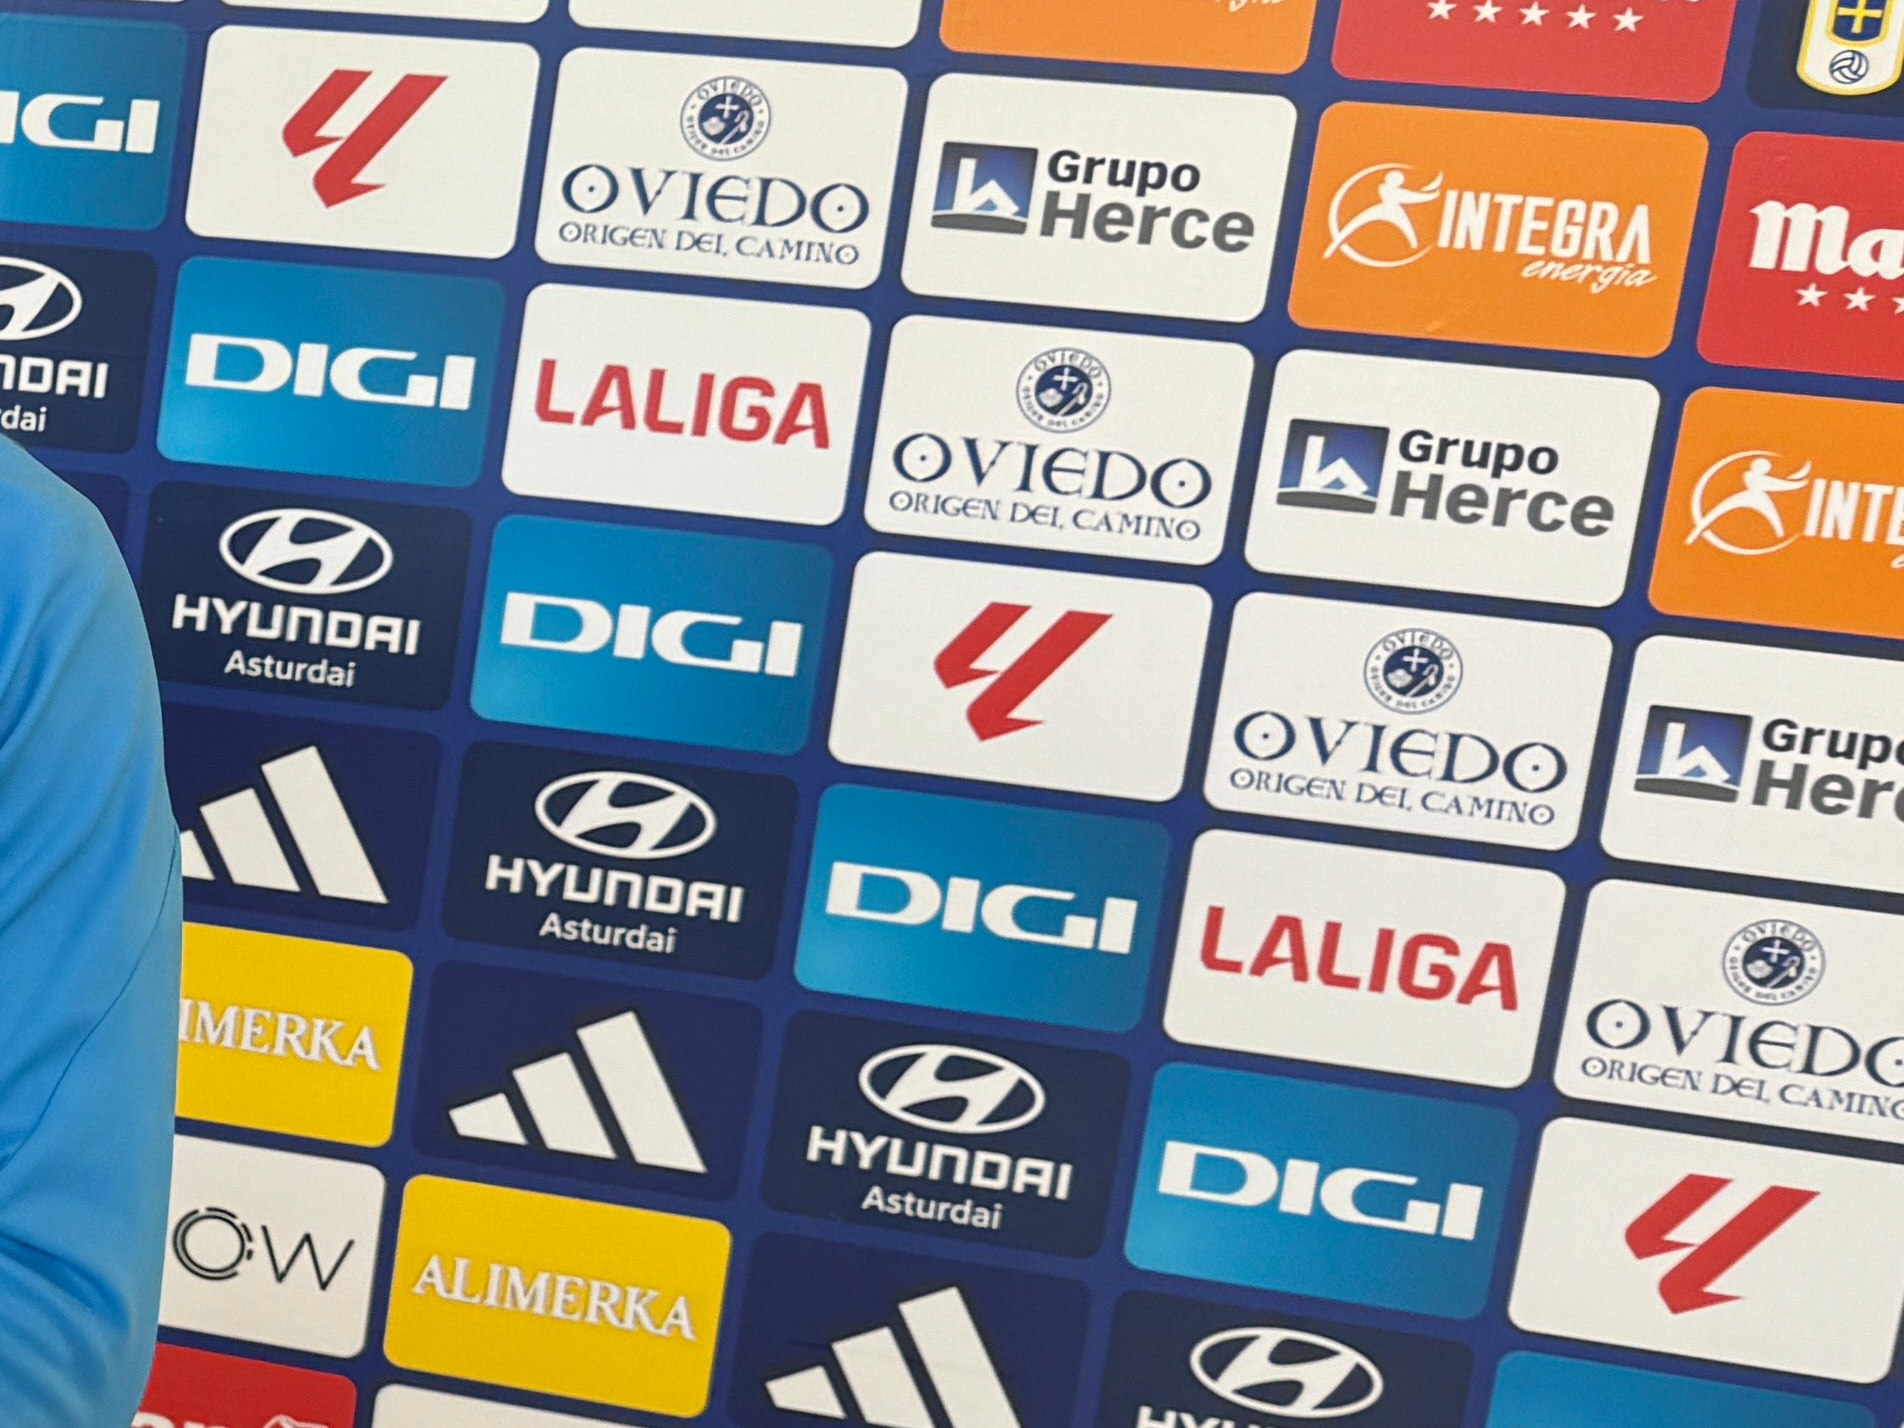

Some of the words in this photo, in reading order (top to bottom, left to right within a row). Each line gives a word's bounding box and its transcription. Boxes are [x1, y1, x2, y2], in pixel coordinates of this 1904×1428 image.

[561, 163, 869, 231] OVIEDO
[1047, 149, 1201, 193] Grupo
[1041, 190, 1255, 253] Herce
[1439, 190, 1651, 264] INTEGRA
[184, 333, 476, 410] DIGI
[534, 359, 831, 450] LALIGA
[892, 434, 1213, 509] OVIEDO
[1399, 430, 1559, 475] Grupo
[889, 490, 1004, 525] ORIGEN
[1012, 499, 1066, 530] DEL
[1072, 504, 1201, 541] CAMINO
[1391, 473, 1615, 537] Herce
[172, 594, 418, 655] HYUNDAI
[500, 592, 804, 677] DIGI
[223, 651, 355, 688] Asturdai
[1235, 711, 1567, 797] OVIEDO
[1229, 768, 1348, 806] ORIGEN
[1355, 779, 1411, 811] DEL
[1417, 789, 1555, 826] CAMINO
[484, 856, 744, 923] HYUNDAI
[1199, 906, 1519, 1012] LALIGA
[179, 999, 379, 1072] IMERKA
[1582, 1056, 1701, 1092] ORIGEN
[1713, 1074, 1769, 1104] DEL
[862, 1187, 1002, 1229] Asturdai
[1158, 1142, 1483, 1242] DIGI
[412, 1254, 695, 1342] ALIMERKA
